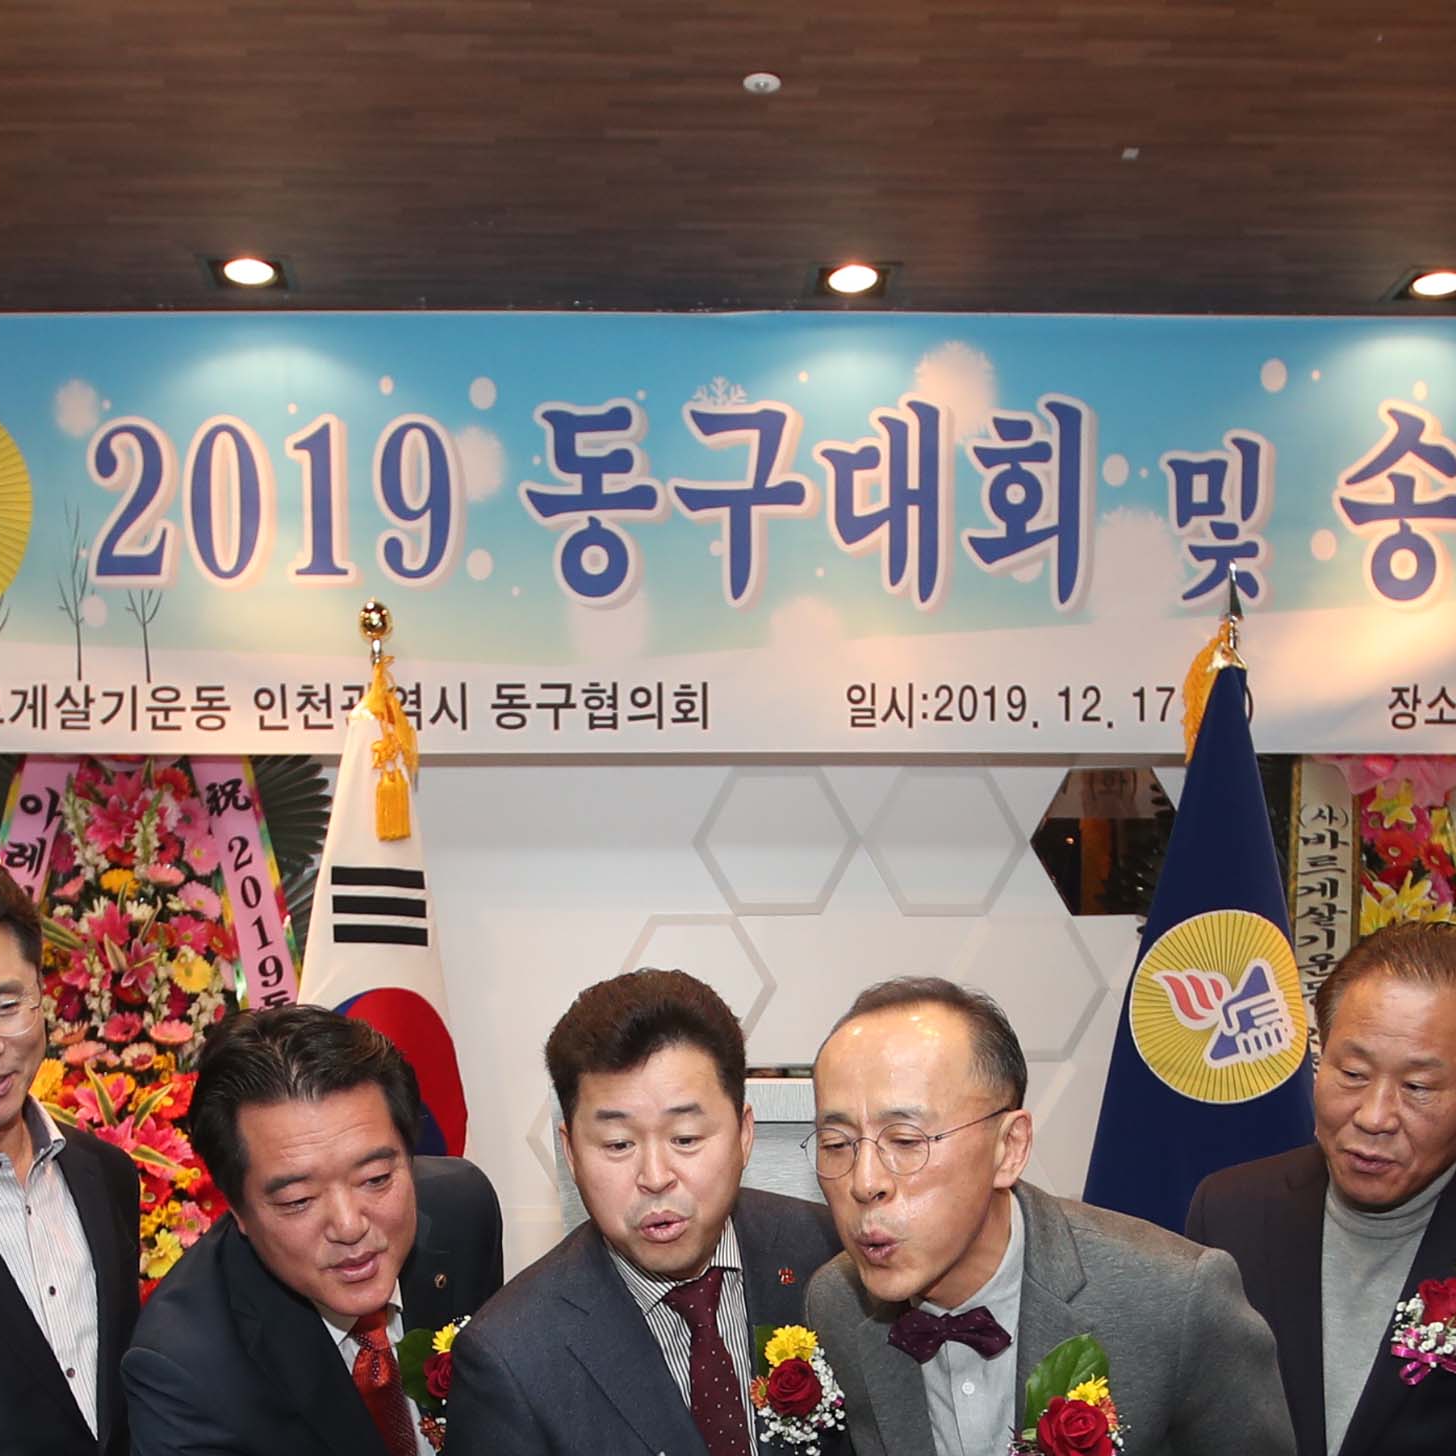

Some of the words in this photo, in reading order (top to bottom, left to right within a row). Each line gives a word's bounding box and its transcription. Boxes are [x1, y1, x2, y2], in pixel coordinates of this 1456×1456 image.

[90, 417, 456, 582] 2019
[526, 400, 1084, 603] 동구대회
[1168, 435, 1259, 600] 및
[490, 680, 710, 732] 동구협의회
[205, 778, 252, 817] 祝
[4, 786, 63, 897] 아레
